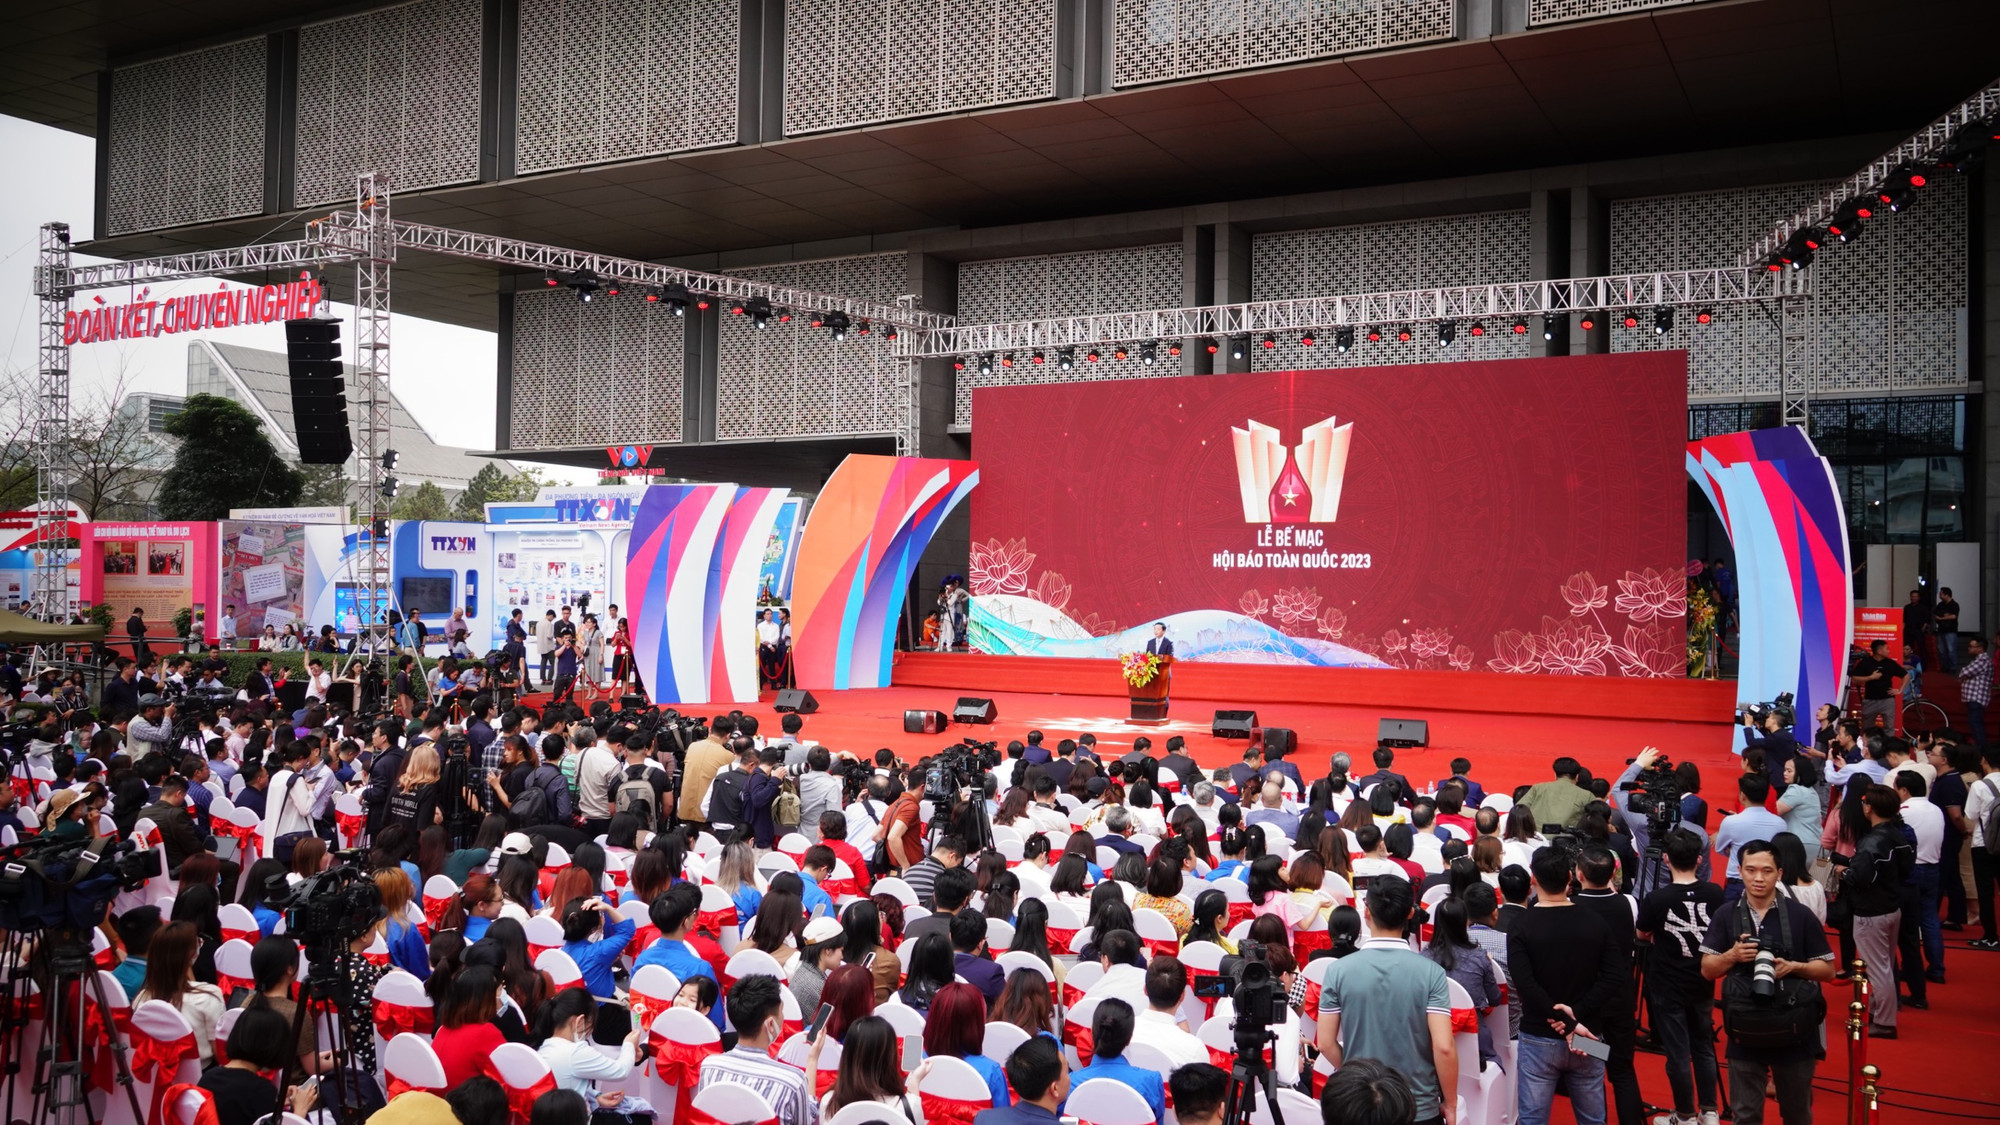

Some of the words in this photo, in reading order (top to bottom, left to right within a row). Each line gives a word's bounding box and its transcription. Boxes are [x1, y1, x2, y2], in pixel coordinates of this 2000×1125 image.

[64, 295, 120, 346] ĐOÀN
[163, 282, 243, 334] CHUYÊN
[606, 445, 654, 467] VOV
[648, 468, 665, 476] NAM
[555, 498, 632, 522] TTXVN
[431, 536, 476, 551] TTXVN
[1257, 524, 1272, 547] LỄ
[1275, 525, 1295, 547] BẾ
[1295, 529, 1324, 549] MẠC
[1213, 550, 1234, 571] HỘI
[1237, 550, 1263, 568] BÁO
[1265, 550, 1300, 568] TOÀN
[1302, 548, 1338, 569] QUỐC
[1340, 553, 1372, 569] 2023
